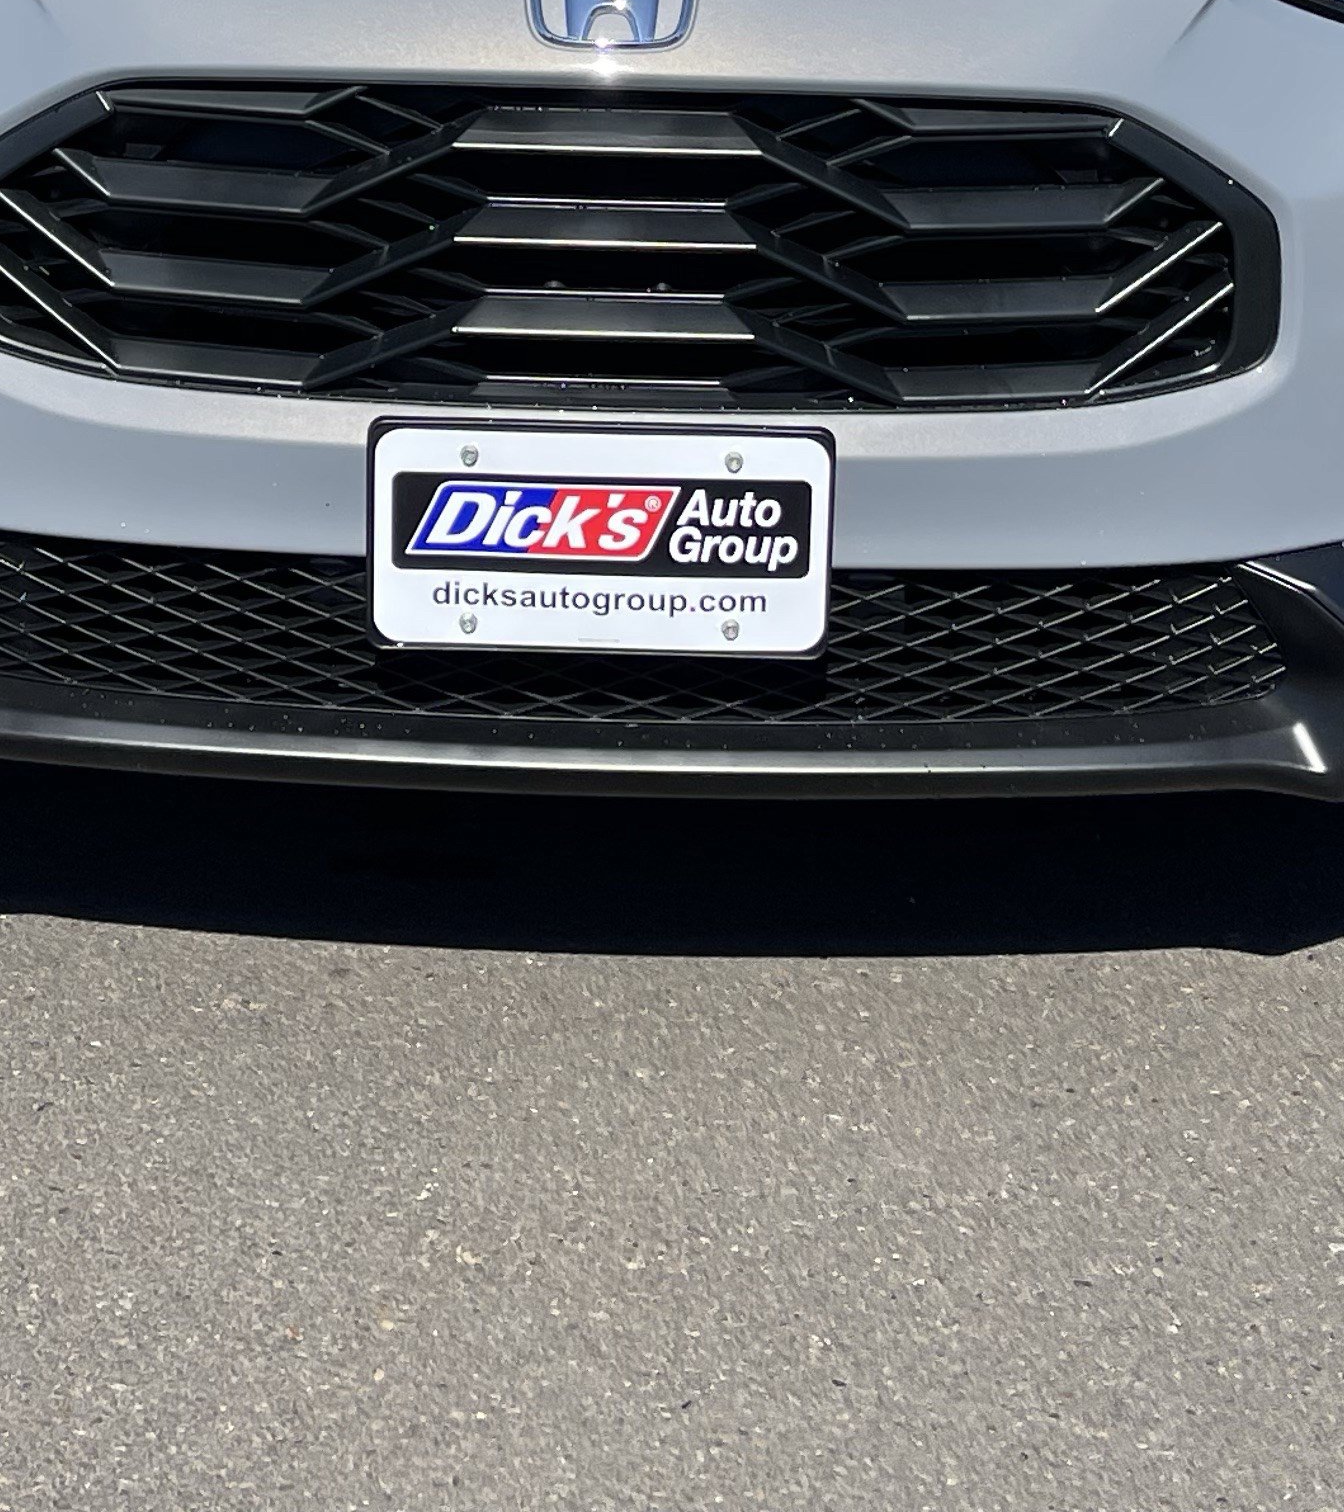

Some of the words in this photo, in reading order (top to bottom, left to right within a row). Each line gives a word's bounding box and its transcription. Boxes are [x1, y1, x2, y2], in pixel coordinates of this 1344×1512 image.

[677, 489, 782, 528] Auto
[668, 527, 799, 571] Group
[432, 581, 768, 617] dicksautogroup.com
